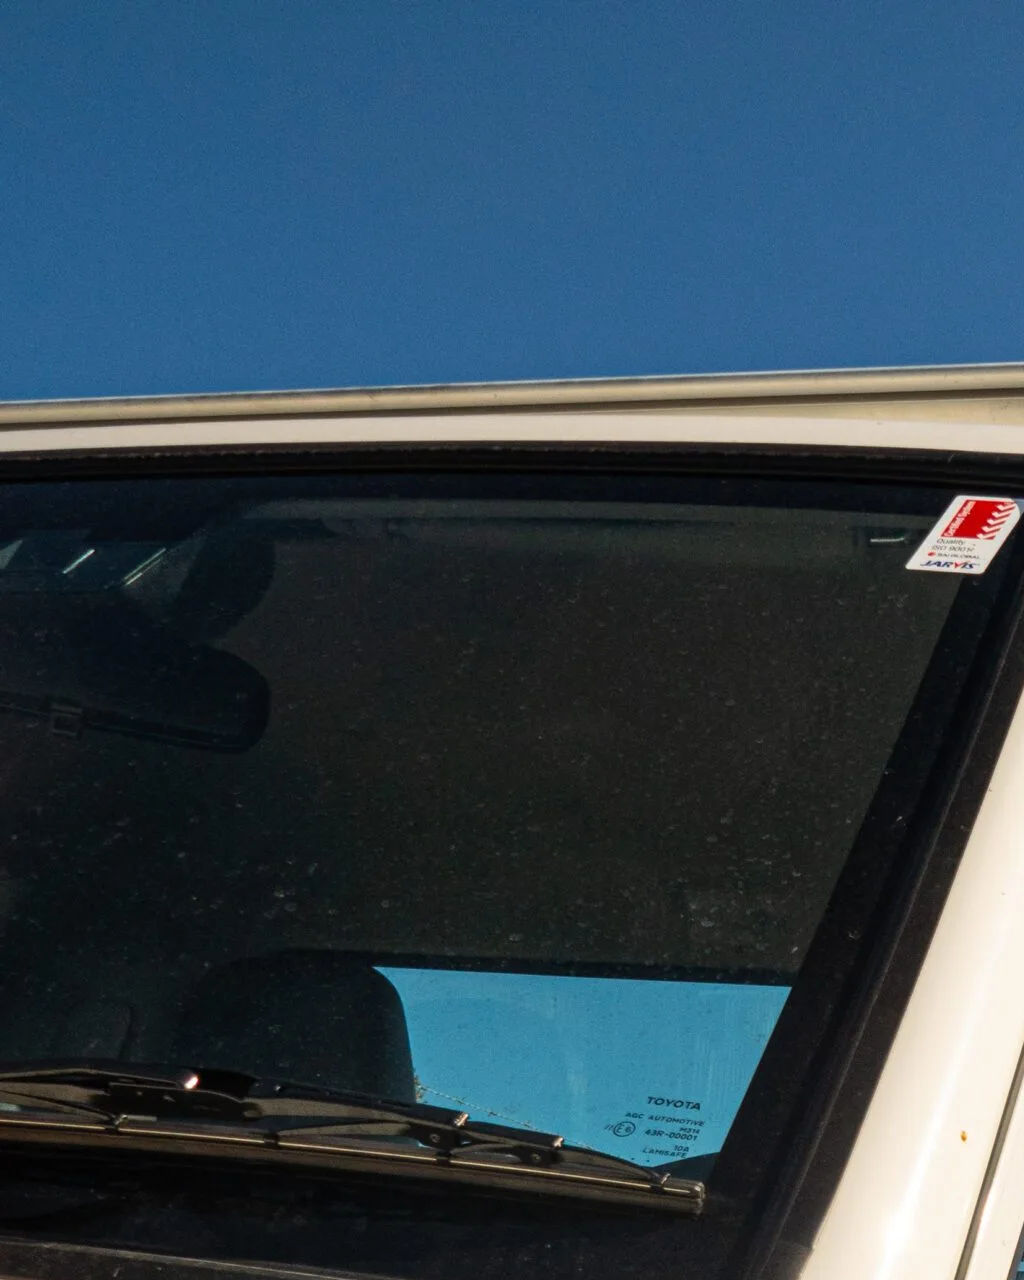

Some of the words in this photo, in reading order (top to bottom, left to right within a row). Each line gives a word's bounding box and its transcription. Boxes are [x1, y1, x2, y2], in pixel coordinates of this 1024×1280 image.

[920, 560, 977, 569] JARVIS
[647, 1096, 701, 1110] TOYOTA
[625, 1112, 645, 1120] AGC
[647, 1114, 705, 1127] AUTOMOTIVE
[645, 1129, 698, 1141] 43R-00001
[642, 1147, 687, 1159] LAMISAFE
